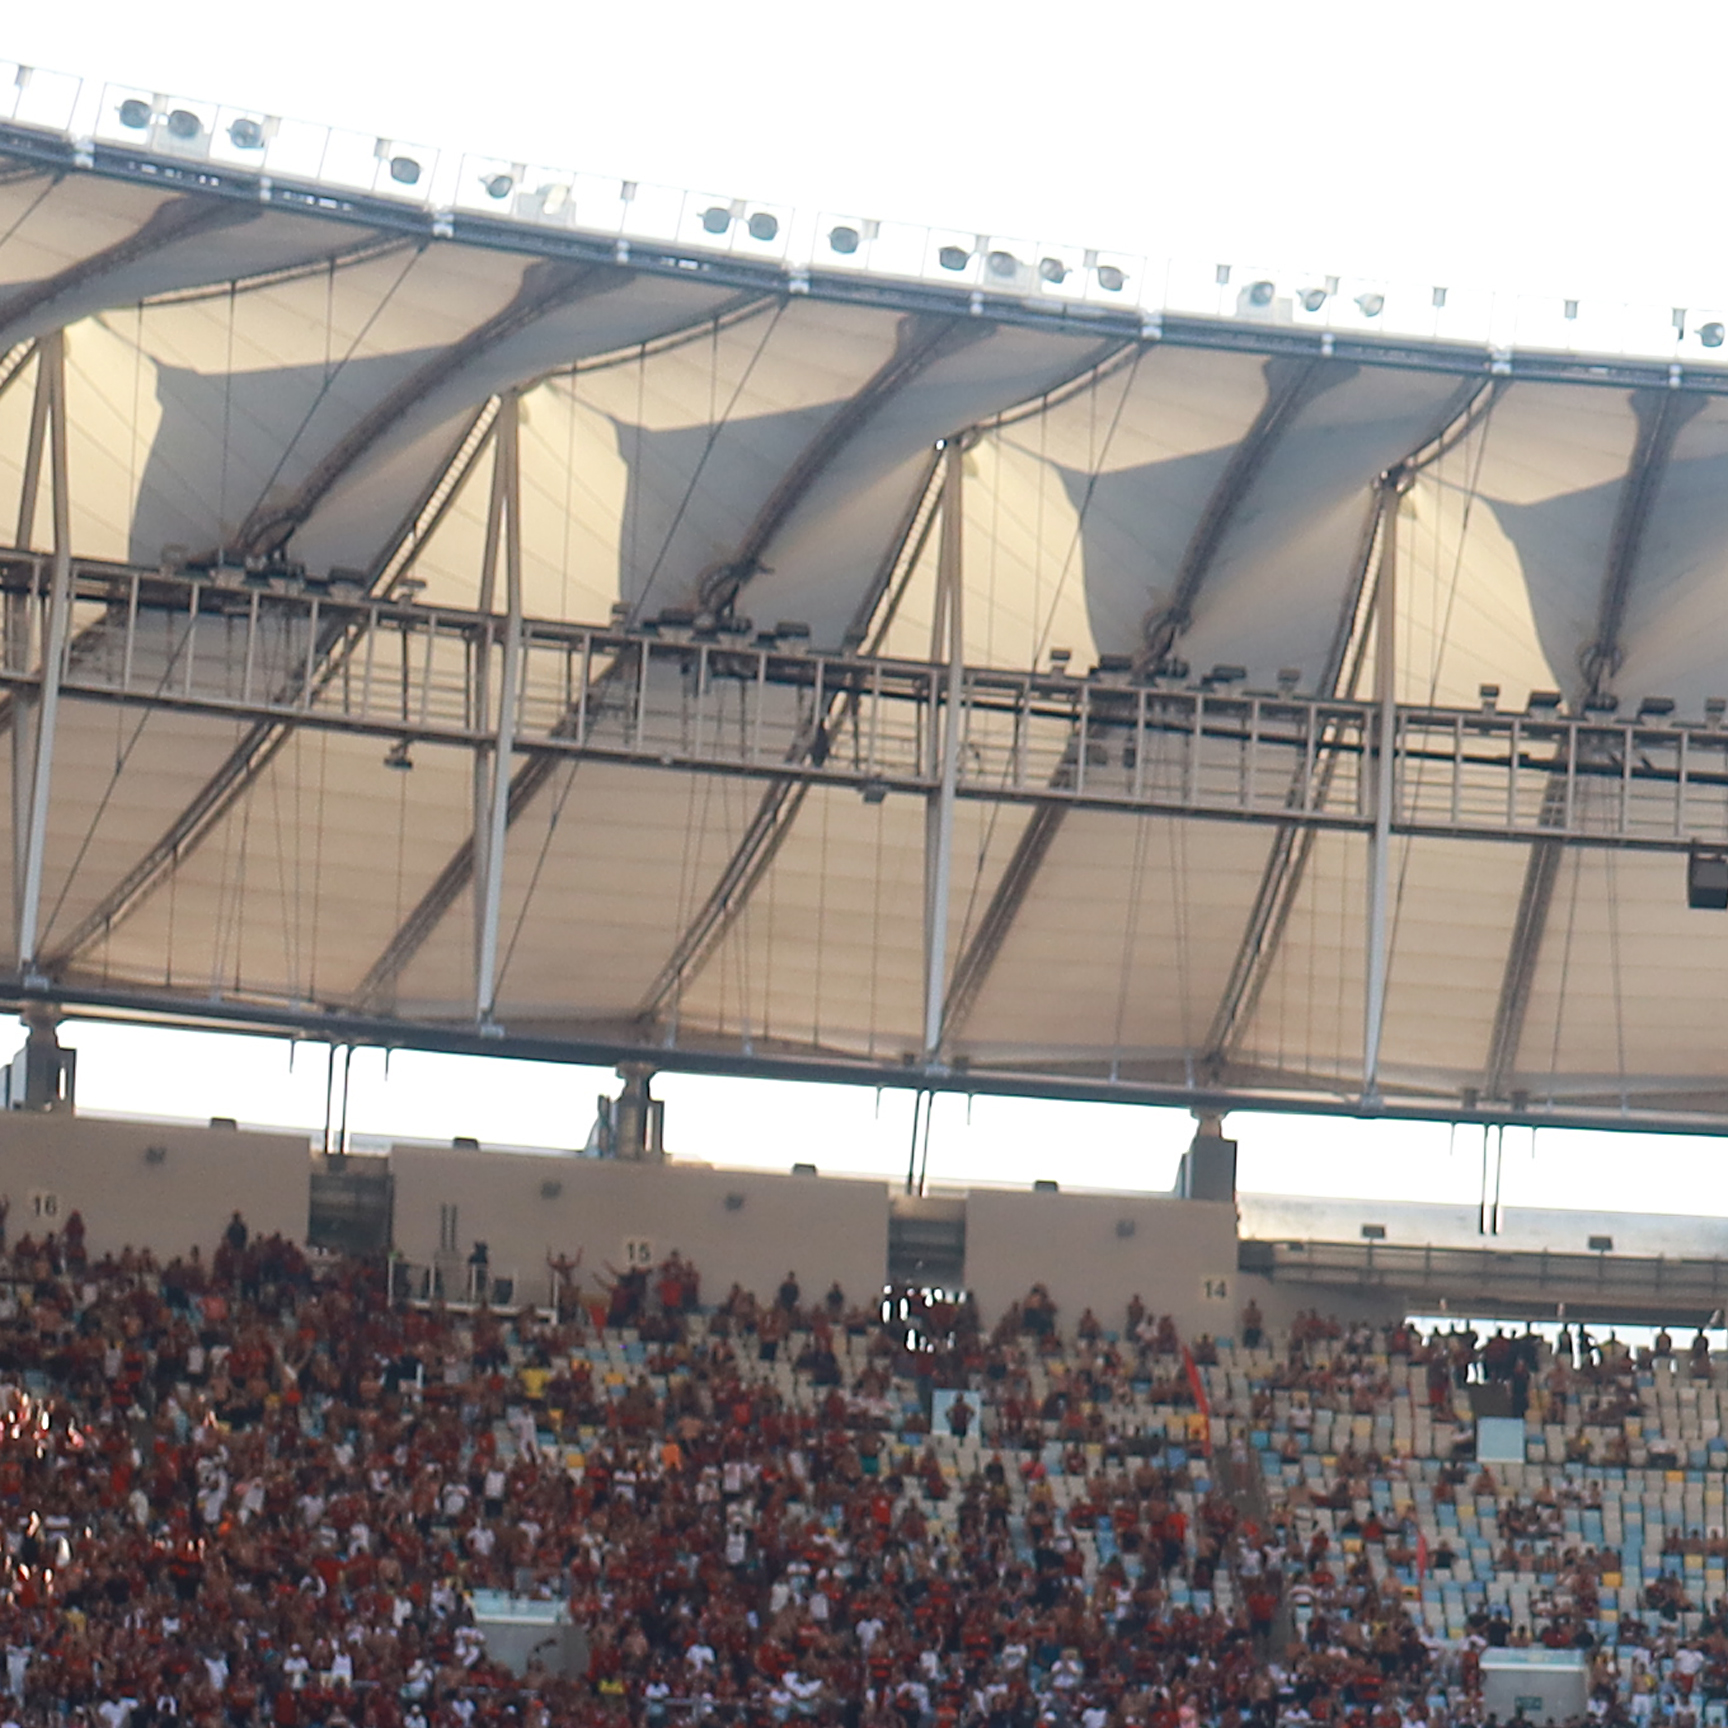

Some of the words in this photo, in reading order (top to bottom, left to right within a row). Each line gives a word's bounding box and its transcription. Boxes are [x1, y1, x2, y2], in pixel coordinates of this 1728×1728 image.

[35, 1195, 57, 1217] 16
[627, 1242, 650, 1261] 15
[1205, 1280, 1227, 1299] 14
